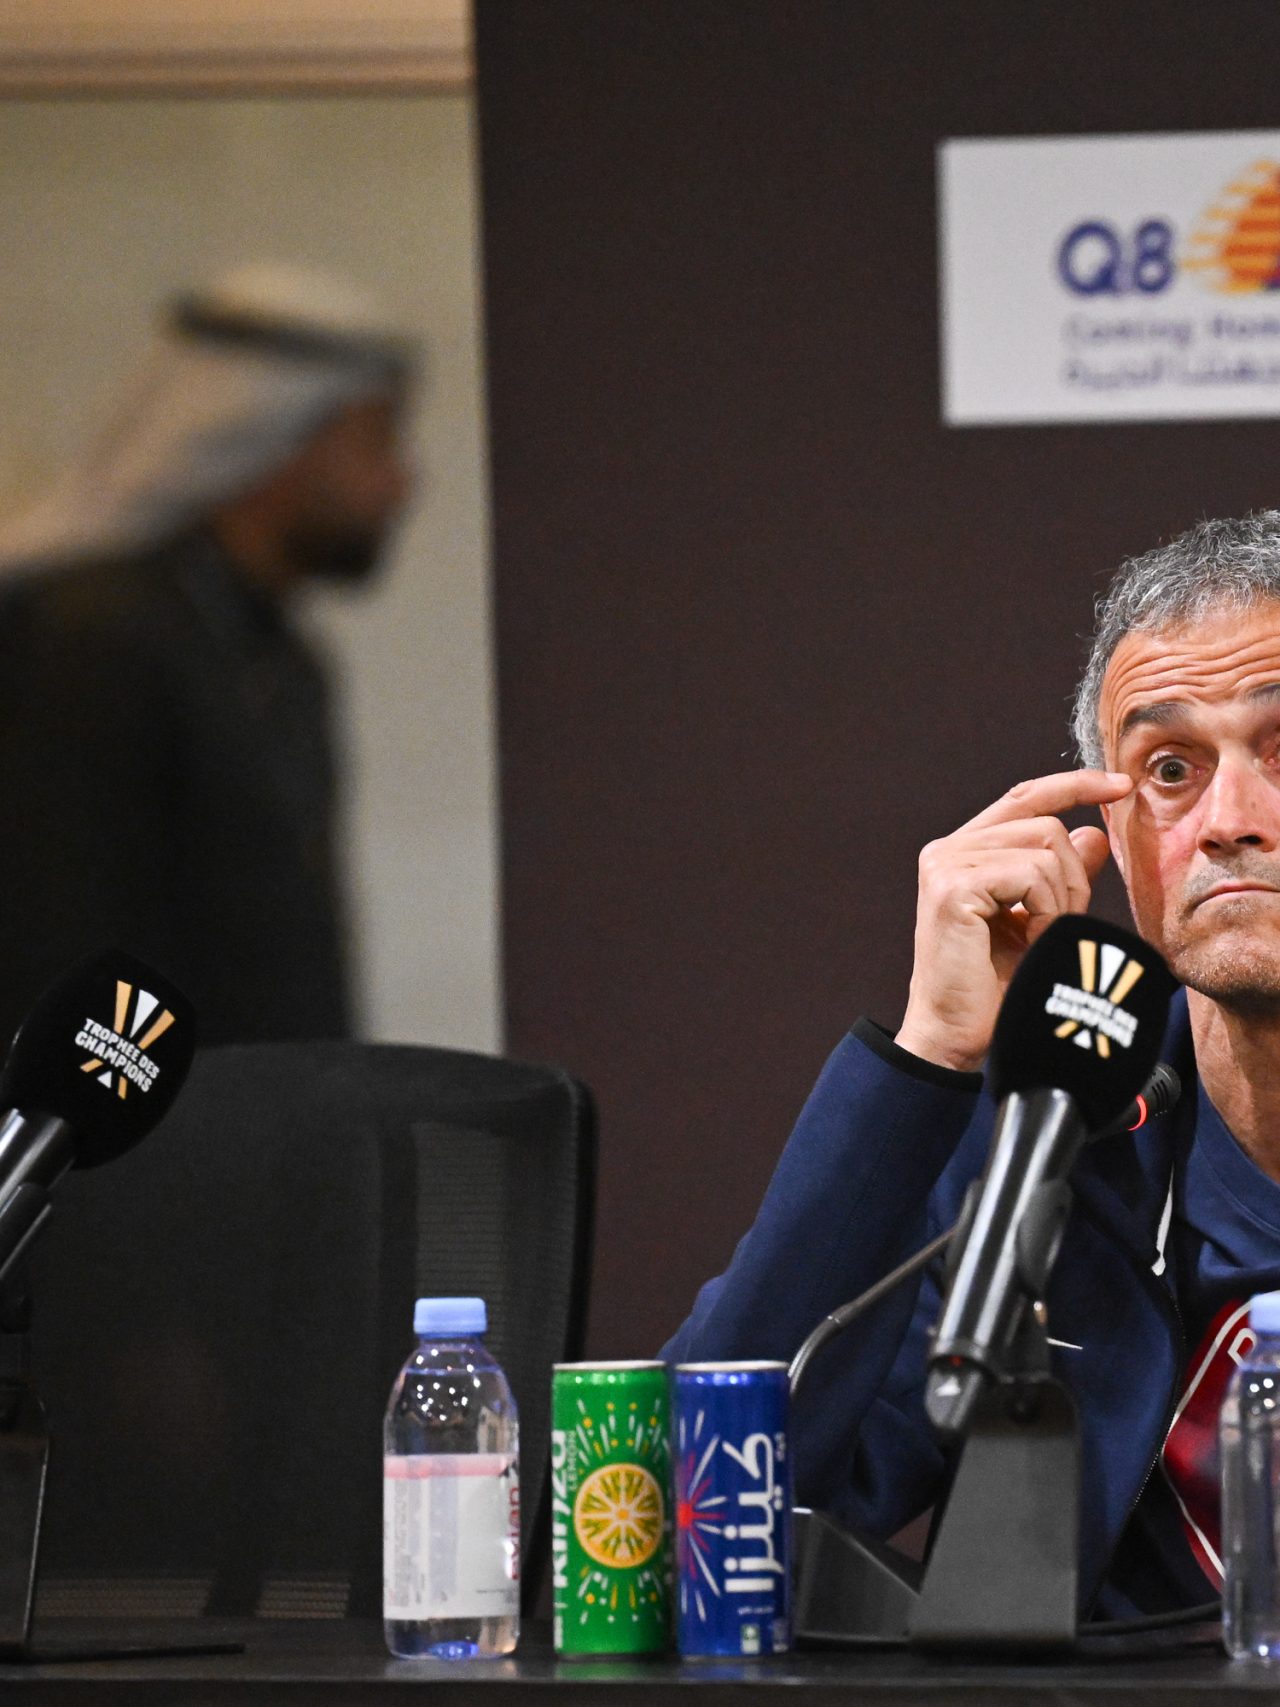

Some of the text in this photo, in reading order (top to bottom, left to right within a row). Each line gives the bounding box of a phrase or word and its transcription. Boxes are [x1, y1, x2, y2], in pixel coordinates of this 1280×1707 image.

[1058, 217, 1176, 297] Q8
[1045, 996, 1135, 1049] CHAMPIONS
[74, 1031, 153, 1093] CHAMPIONS
[138, 1053, 160, 1079] DES
[568, 1429, 577, 1491] LEMON
[721, 1432, 785, 1593] كينزا
